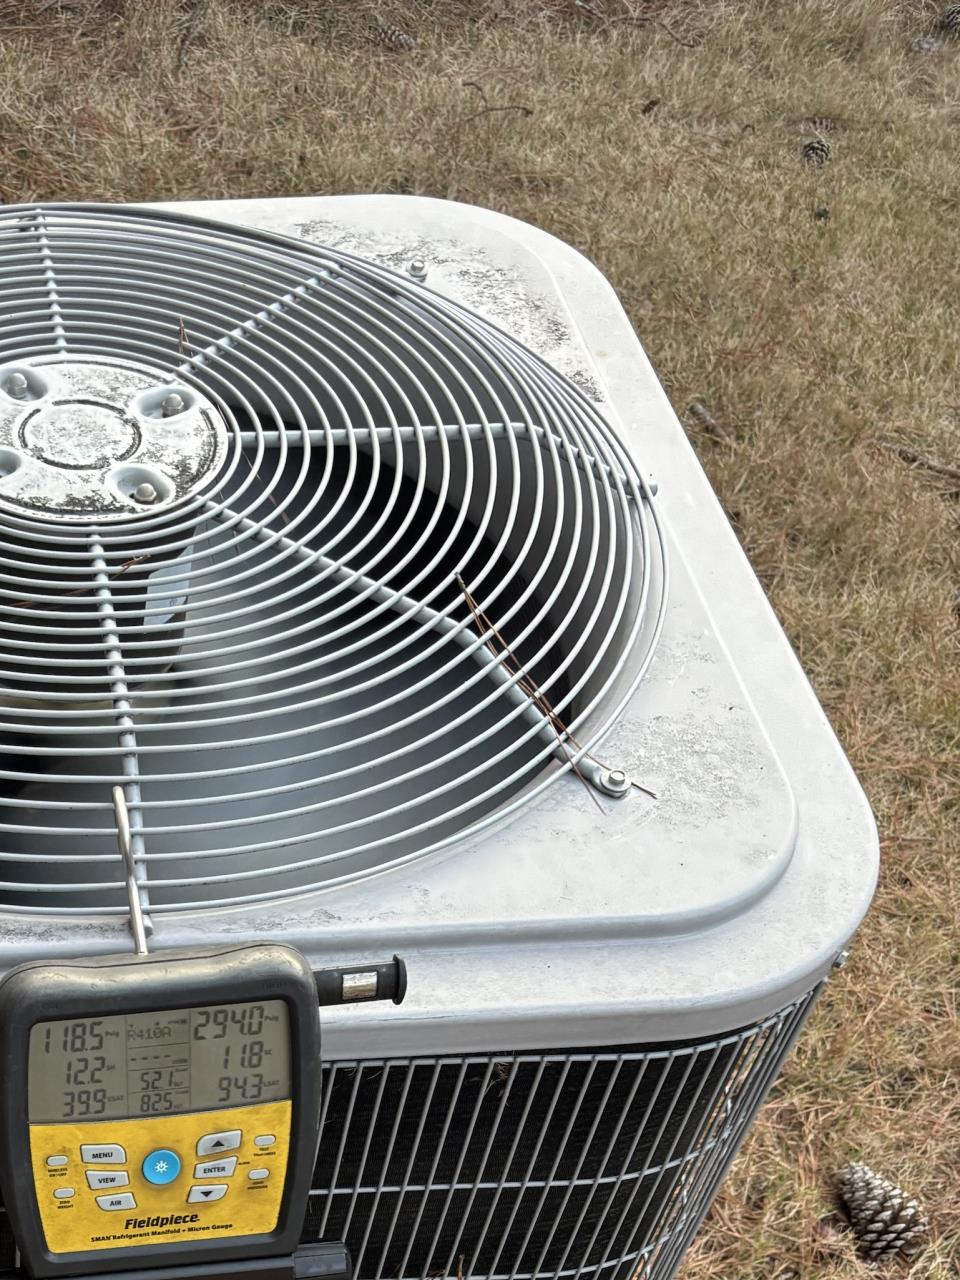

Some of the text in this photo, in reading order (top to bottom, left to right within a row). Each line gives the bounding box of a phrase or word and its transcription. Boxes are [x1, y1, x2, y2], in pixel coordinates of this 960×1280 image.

[193, 1006, 264, 1041] 294.0
[45, 1021, 103, 1054] 118.5
[127, 1026, 172, 1041] R410A
[66, 1056, 106, 1085] 12.2
[203, 1166, 226, 1174] ENTER
[124, 1214, 199, 1229] Fieldpiece
[112, 1231, 150, 1241] Refrigerant
[151, 1228, 180, 1236] Manifold
[187, 1225, 210, 1233] Micron
